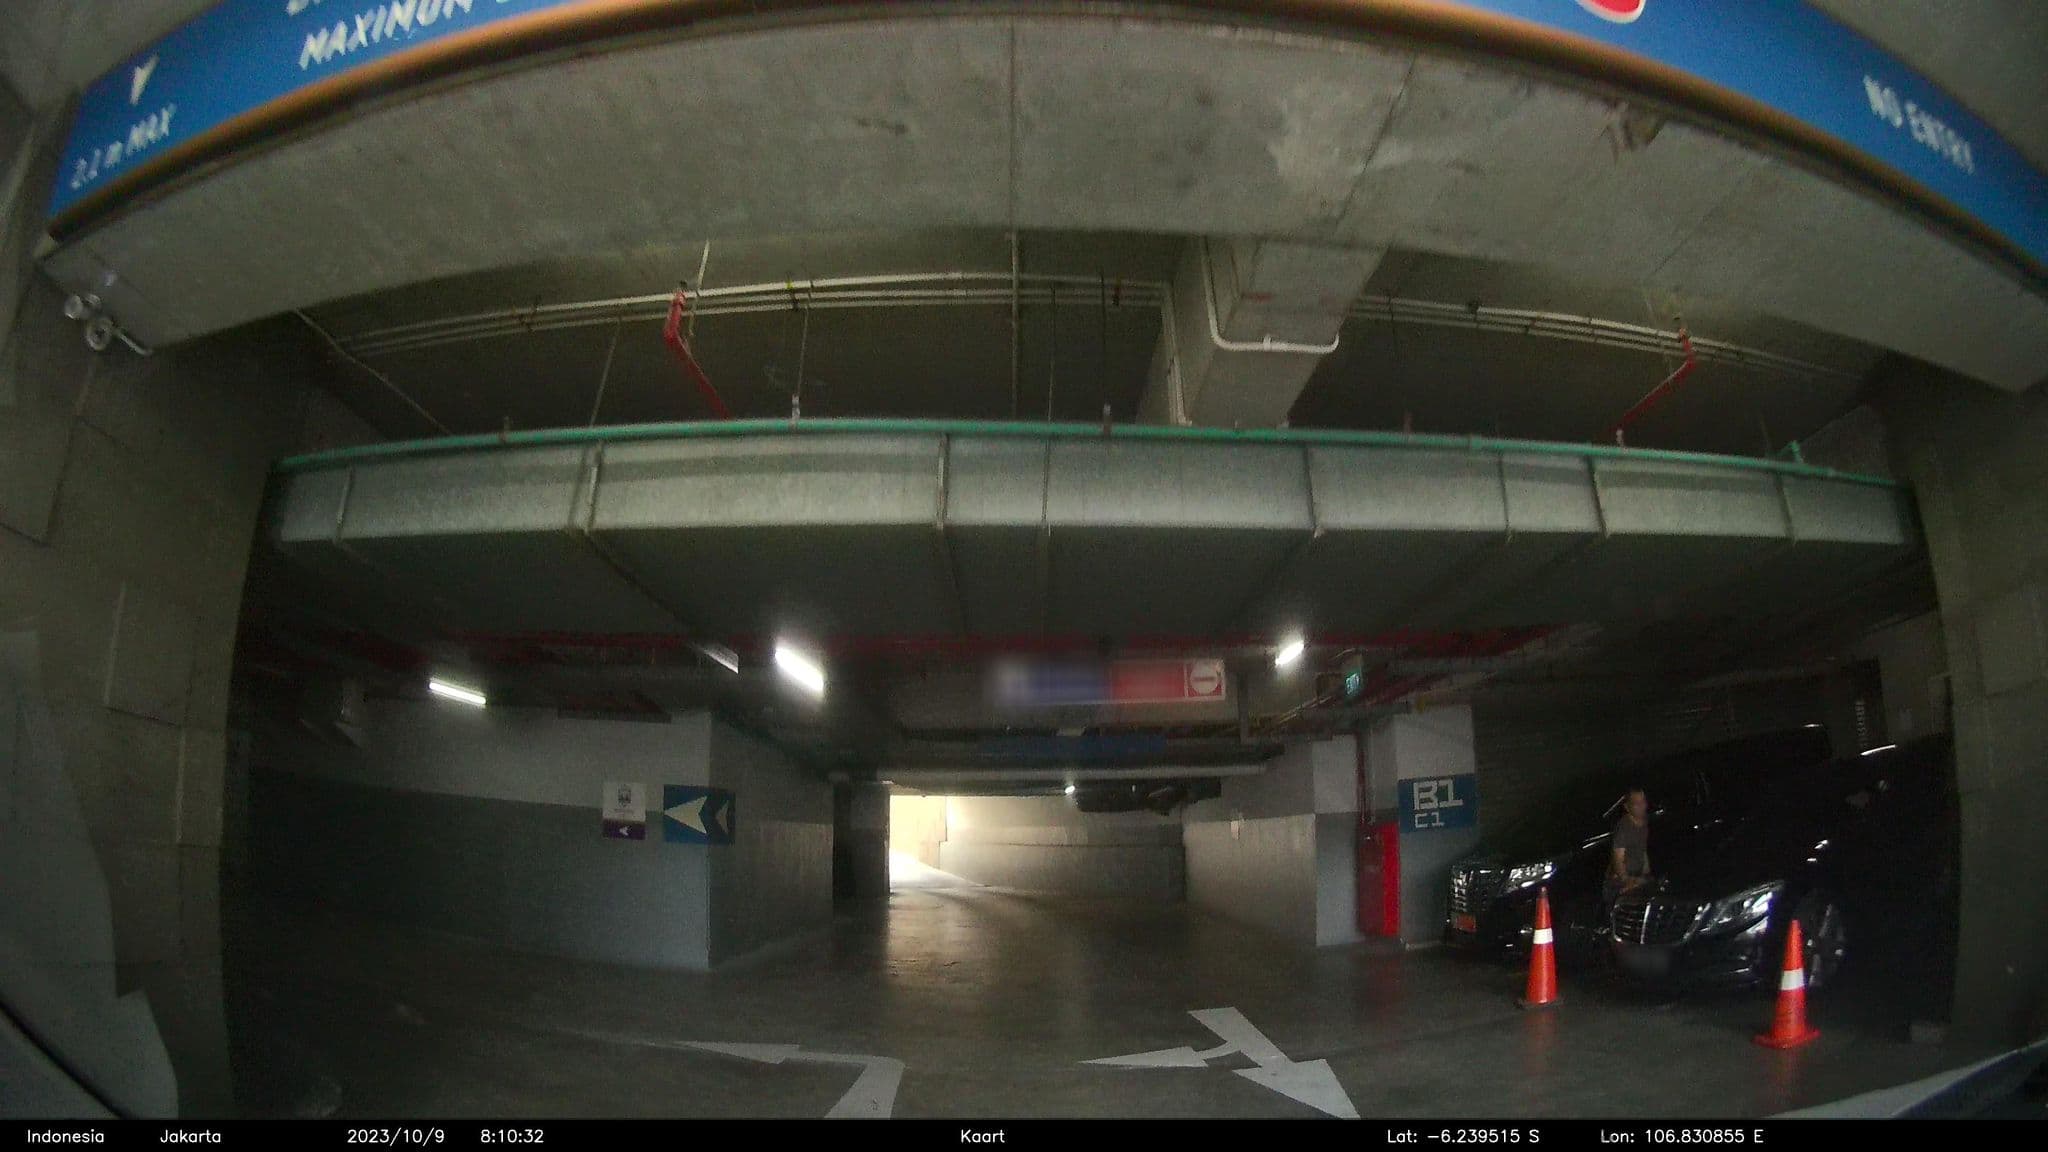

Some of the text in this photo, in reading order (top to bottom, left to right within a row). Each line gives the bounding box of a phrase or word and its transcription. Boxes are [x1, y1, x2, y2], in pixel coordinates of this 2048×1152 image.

[1863, 75, 1976, 176] NO ENTRY
[1413, 779, 1464, 810] B1
[1414, 811, 1445, 828] C1
